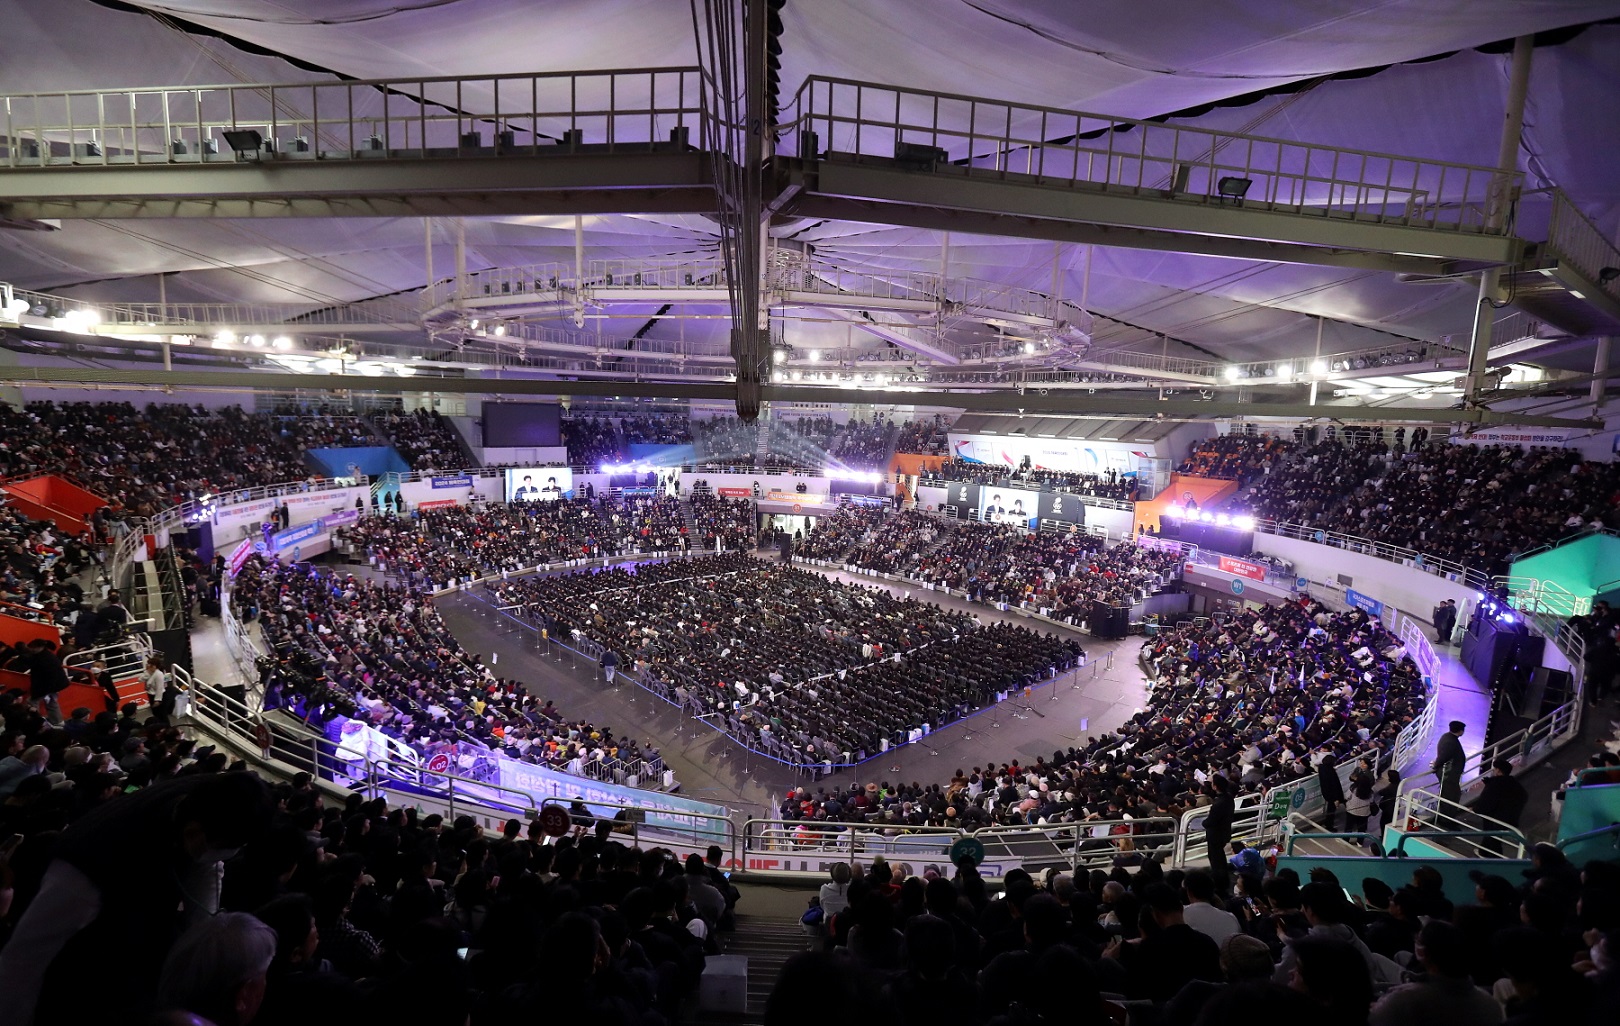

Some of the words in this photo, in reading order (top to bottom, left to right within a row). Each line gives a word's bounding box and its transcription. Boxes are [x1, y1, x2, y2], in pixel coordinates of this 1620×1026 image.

[1233, 582, 1242, 591] W1
[546, 814, 562, 827] 33
[960, 847, 977, 859] 32
